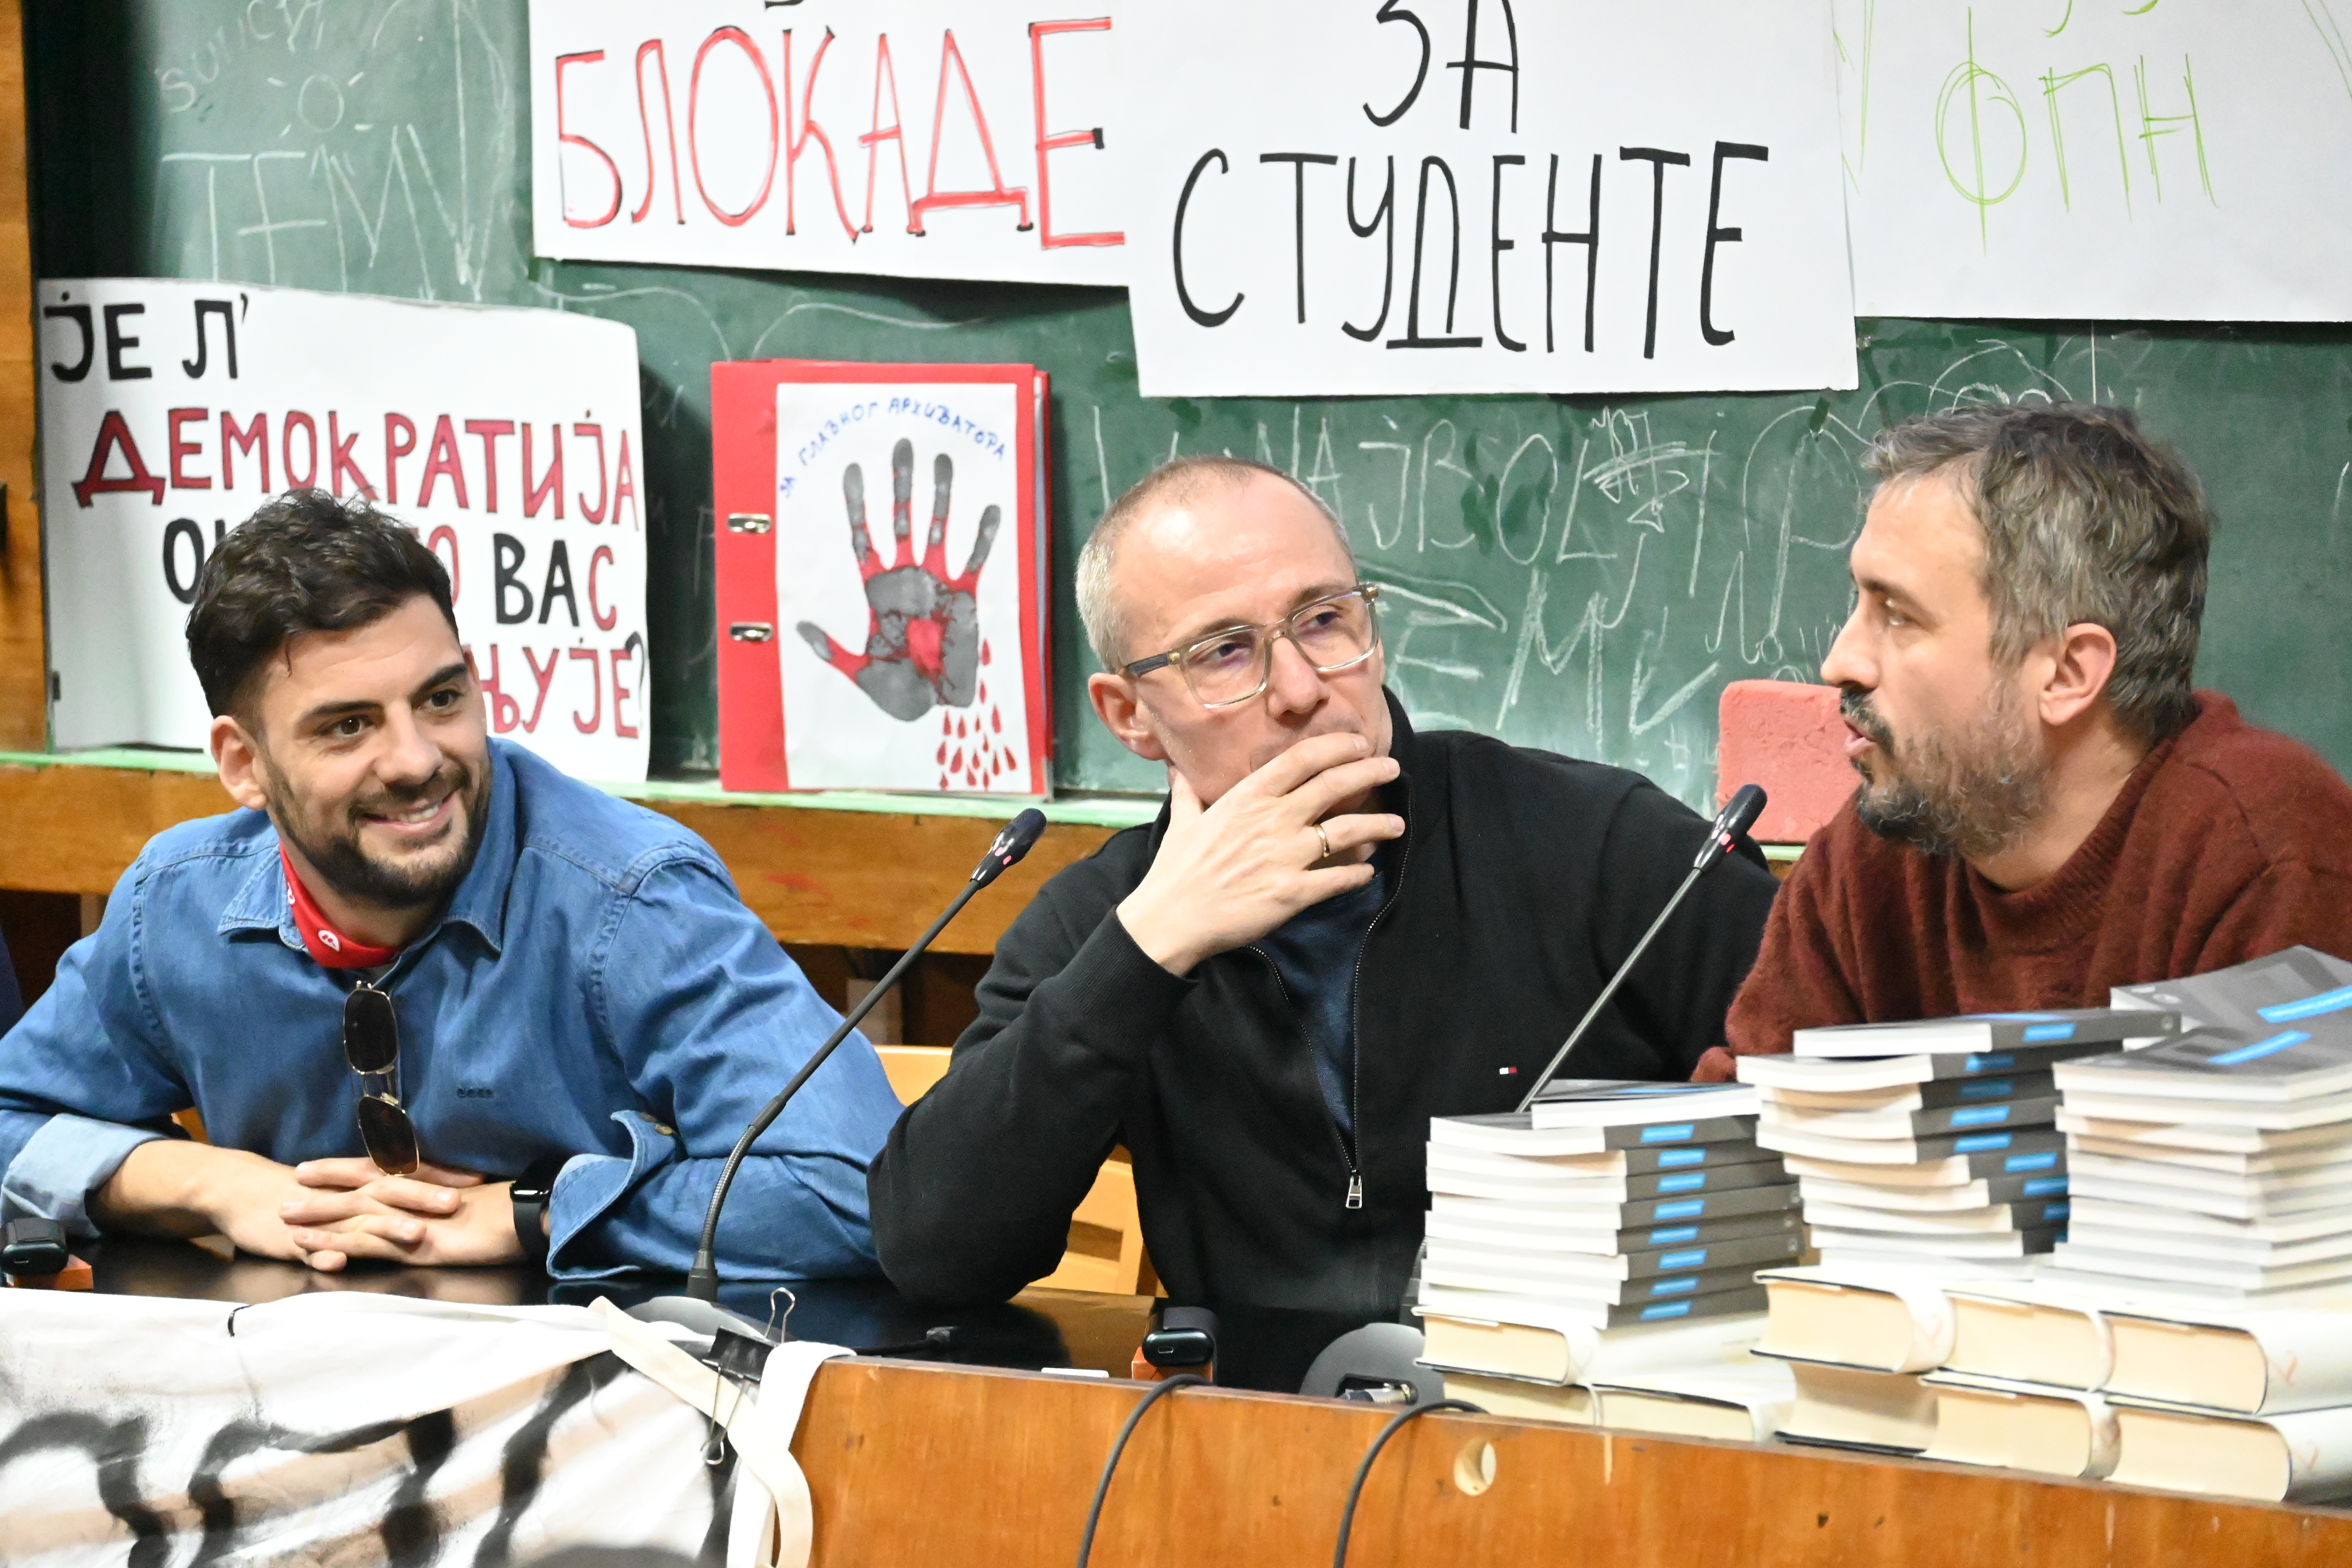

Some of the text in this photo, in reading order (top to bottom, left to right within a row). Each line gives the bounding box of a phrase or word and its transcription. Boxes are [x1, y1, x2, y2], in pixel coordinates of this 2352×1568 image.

[1362, 0, 1521, 134] ЗА
[1936, 6, 2220, 256] ФПН
[555, 17, 1125, 249] БЛОКАДЕ
[1173, 142, 1769, 360] СТУДЕНТЕ
[44, 291, 152, 382] ЈЕ
[71, 405, 641, 532] ДЕМОКРАТИЈА
[493, 531, 618, 631] ВАС
[460, 631, 645, 739] ЊУЈЕ?
